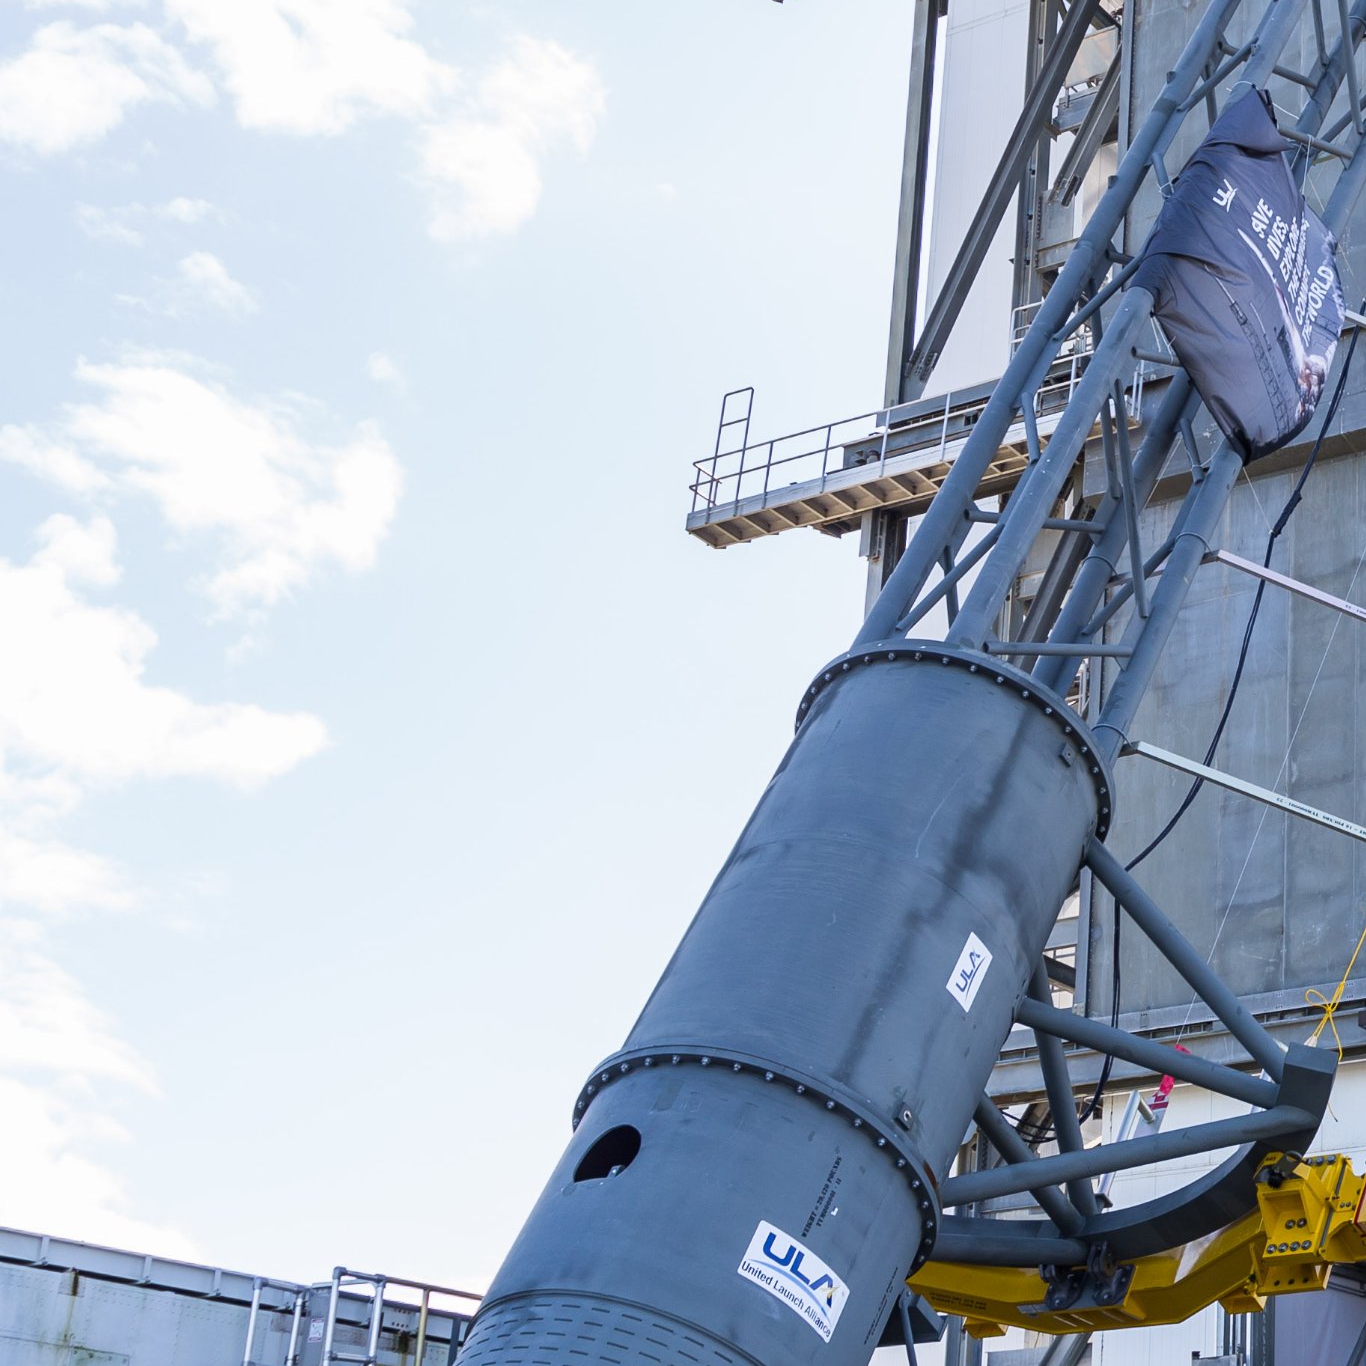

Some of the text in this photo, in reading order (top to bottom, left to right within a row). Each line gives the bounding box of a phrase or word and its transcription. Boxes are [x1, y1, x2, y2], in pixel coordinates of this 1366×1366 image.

[1250, 198, 1273, 239] SAVE
[1308, 265, 1334, 322] WORLD
[955, 948, 981, 993] ULA
[801, 1211, 817, 1238] WEIGHT
[827, 1156, 842, 1184] POUNDS
[741, 1260, 831, 1338] United Launch Alliance
[762, 1231, 834, 1310] ULA
